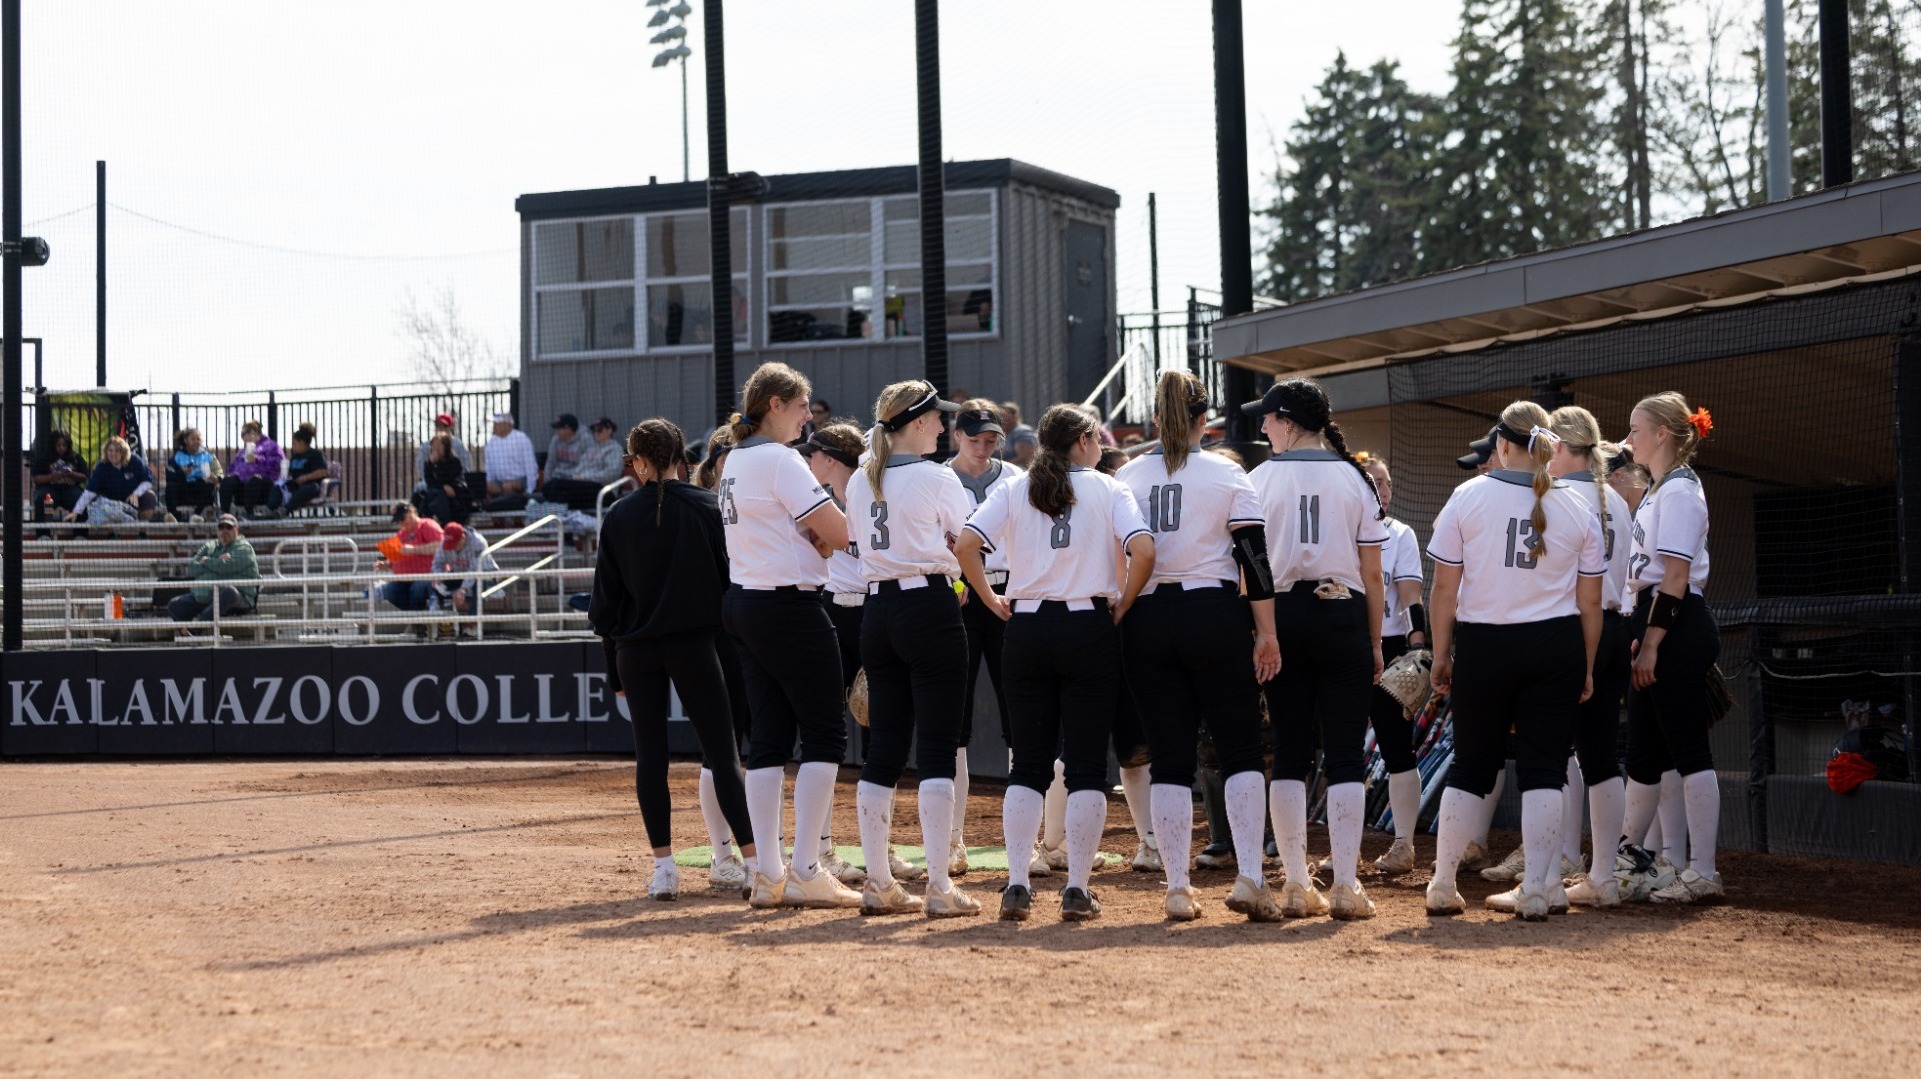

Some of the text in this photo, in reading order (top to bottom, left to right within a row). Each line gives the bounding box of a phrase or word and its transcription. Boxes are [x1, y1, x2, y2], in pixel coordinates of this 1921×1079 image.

[720, 478, 738, 525] 25
[871, 501, 890, 550] 3
[1050, 503, 1072, 549] 8
[1149, 483, 1183, 533] 10
[1299, 495, 1320, 544] 11
[1504, 517, 1543, 569] 13
[1628, 552, 1651, 580] 17
[8, 673, 691, 727] KALAMAZOO COLLE
